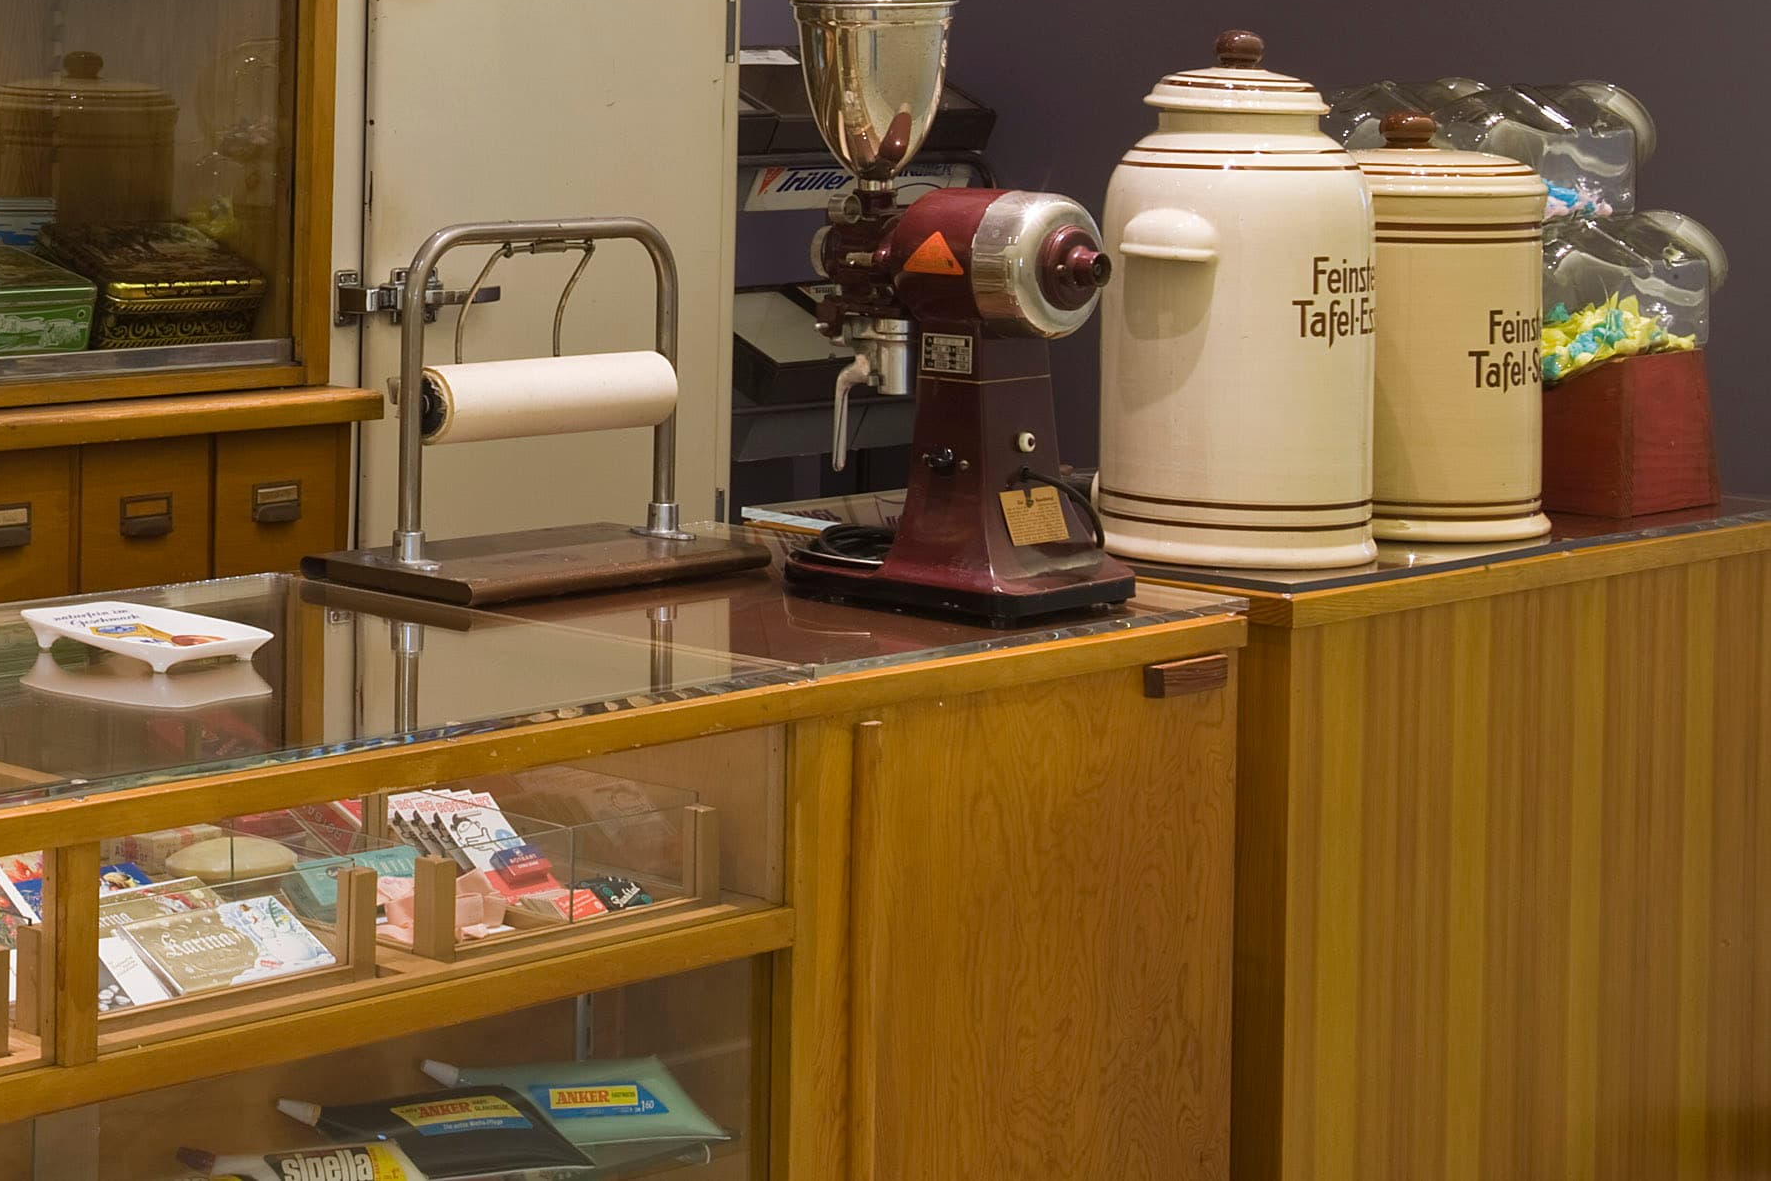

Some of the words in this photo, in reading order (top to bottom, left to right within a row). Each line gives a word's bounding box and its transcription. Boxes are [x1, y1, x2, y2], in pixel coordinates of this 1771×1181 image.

[1488, 307, 1543, 345] Feinst
[160, 928, 239, 959] Karina
[555, 1089, 610, 1106] ANKER
[418, 1101, 473, 1119] ANKER
